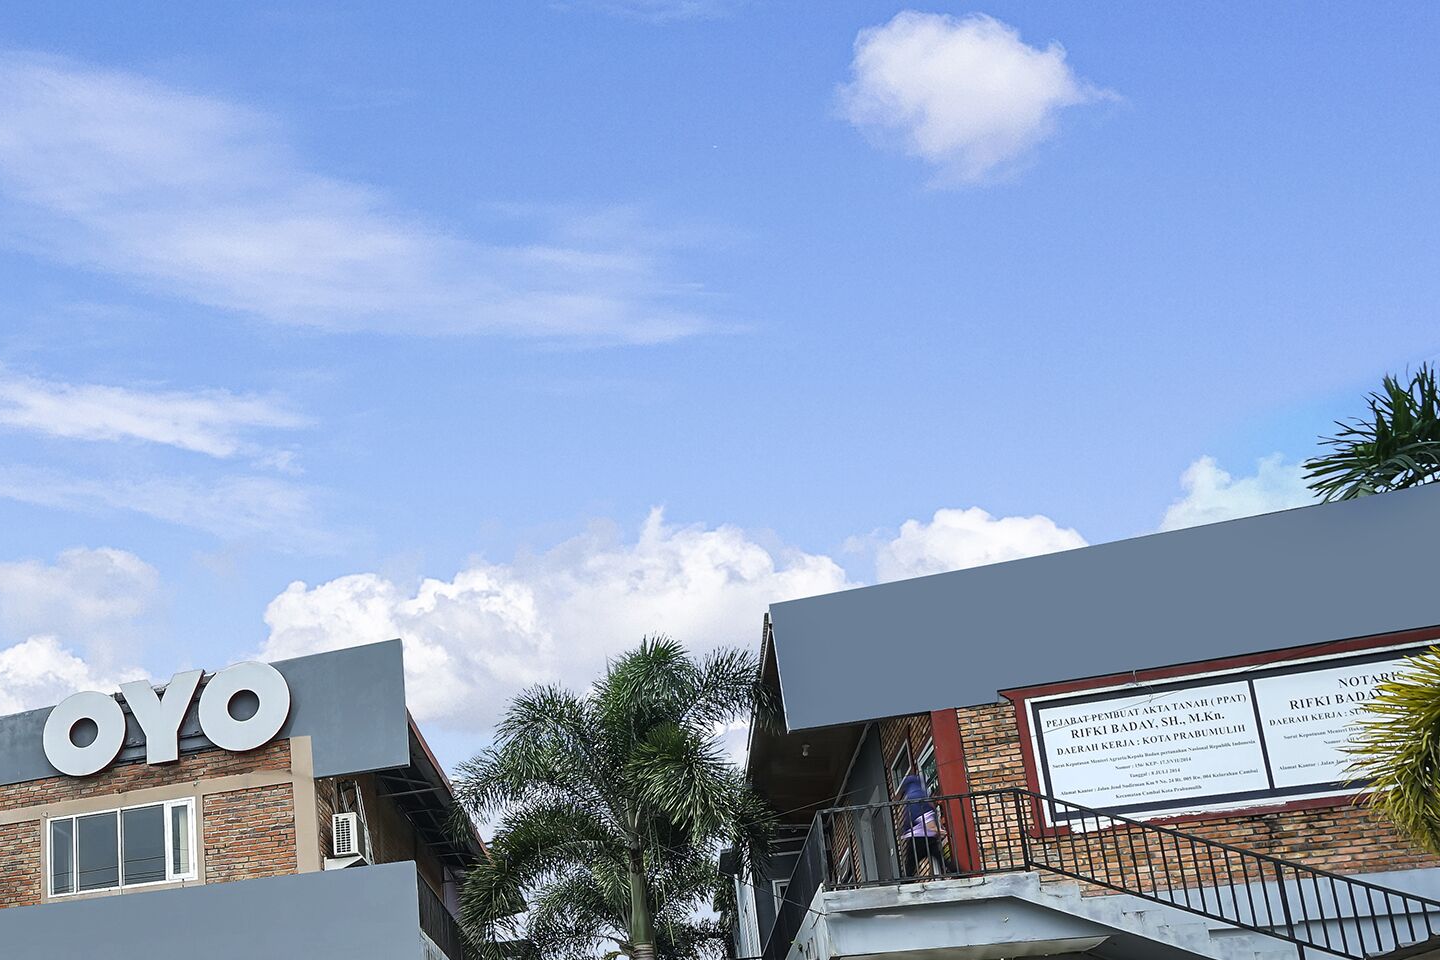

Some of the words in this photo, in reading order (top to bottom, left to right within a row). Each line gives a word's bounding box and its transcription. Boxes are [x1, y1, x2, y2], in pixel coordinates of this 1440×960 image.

[1338, 670, 1405, 688] NOTARIS
[1046, 715, 1089, 728] PEJABAT
[1092, 708, 1140, 722] PEMBUAT
[1142, 705, 1170, 715] AKTA
[1171, 699, 1208, 711] TANAH
[1289, 695, 1331, 710] RIFKI
[42, 661, 292, 777] OYO
[1070, 725, 1107, 739] RIFKI
[1111, 718, 1159, 734] BADAY,
[1161, 716, 1186, 727] SH.,
[1189, 711, 1225, 723] M.Kn.
[1269, 715, 1309, 726] DAERAH
[1311, 711, 1343, 721] KERJA
[1056, 744, 1099, 756] DAERAH
[1101, 739, 1135, 750] KERJA
[1142, 734, 1172, 745] KOTA
[1173, 724, 1246, 741] PRABUMULIH
